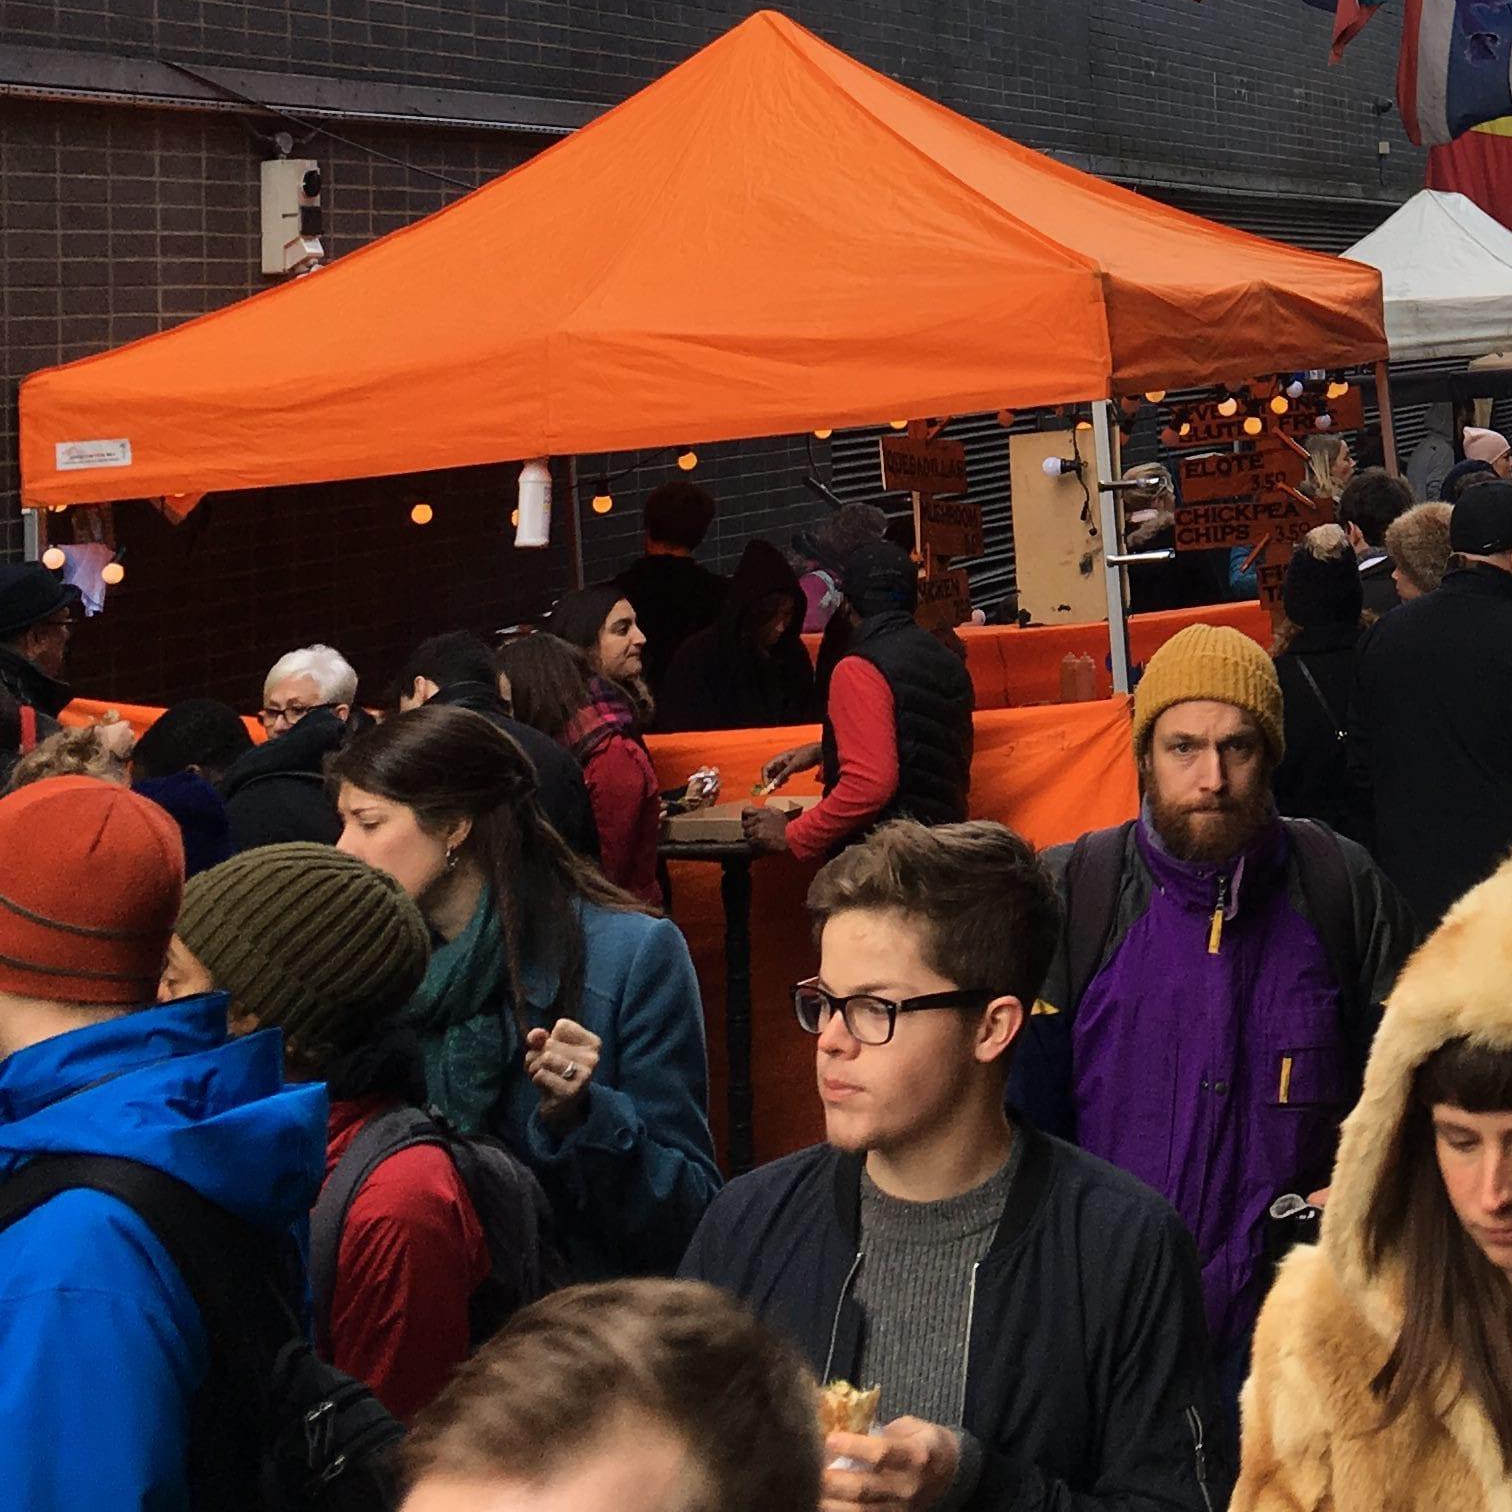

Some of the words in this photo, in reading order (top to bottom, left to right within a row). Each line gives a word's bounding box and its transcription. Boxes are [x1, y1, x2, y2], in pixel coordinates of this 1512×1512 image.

[1184, 453, 1264, 479] ELOTE
[1176, 502, 1300, 525] CHICKPEA
[1177, 524, 1250, 545] CHIPS
